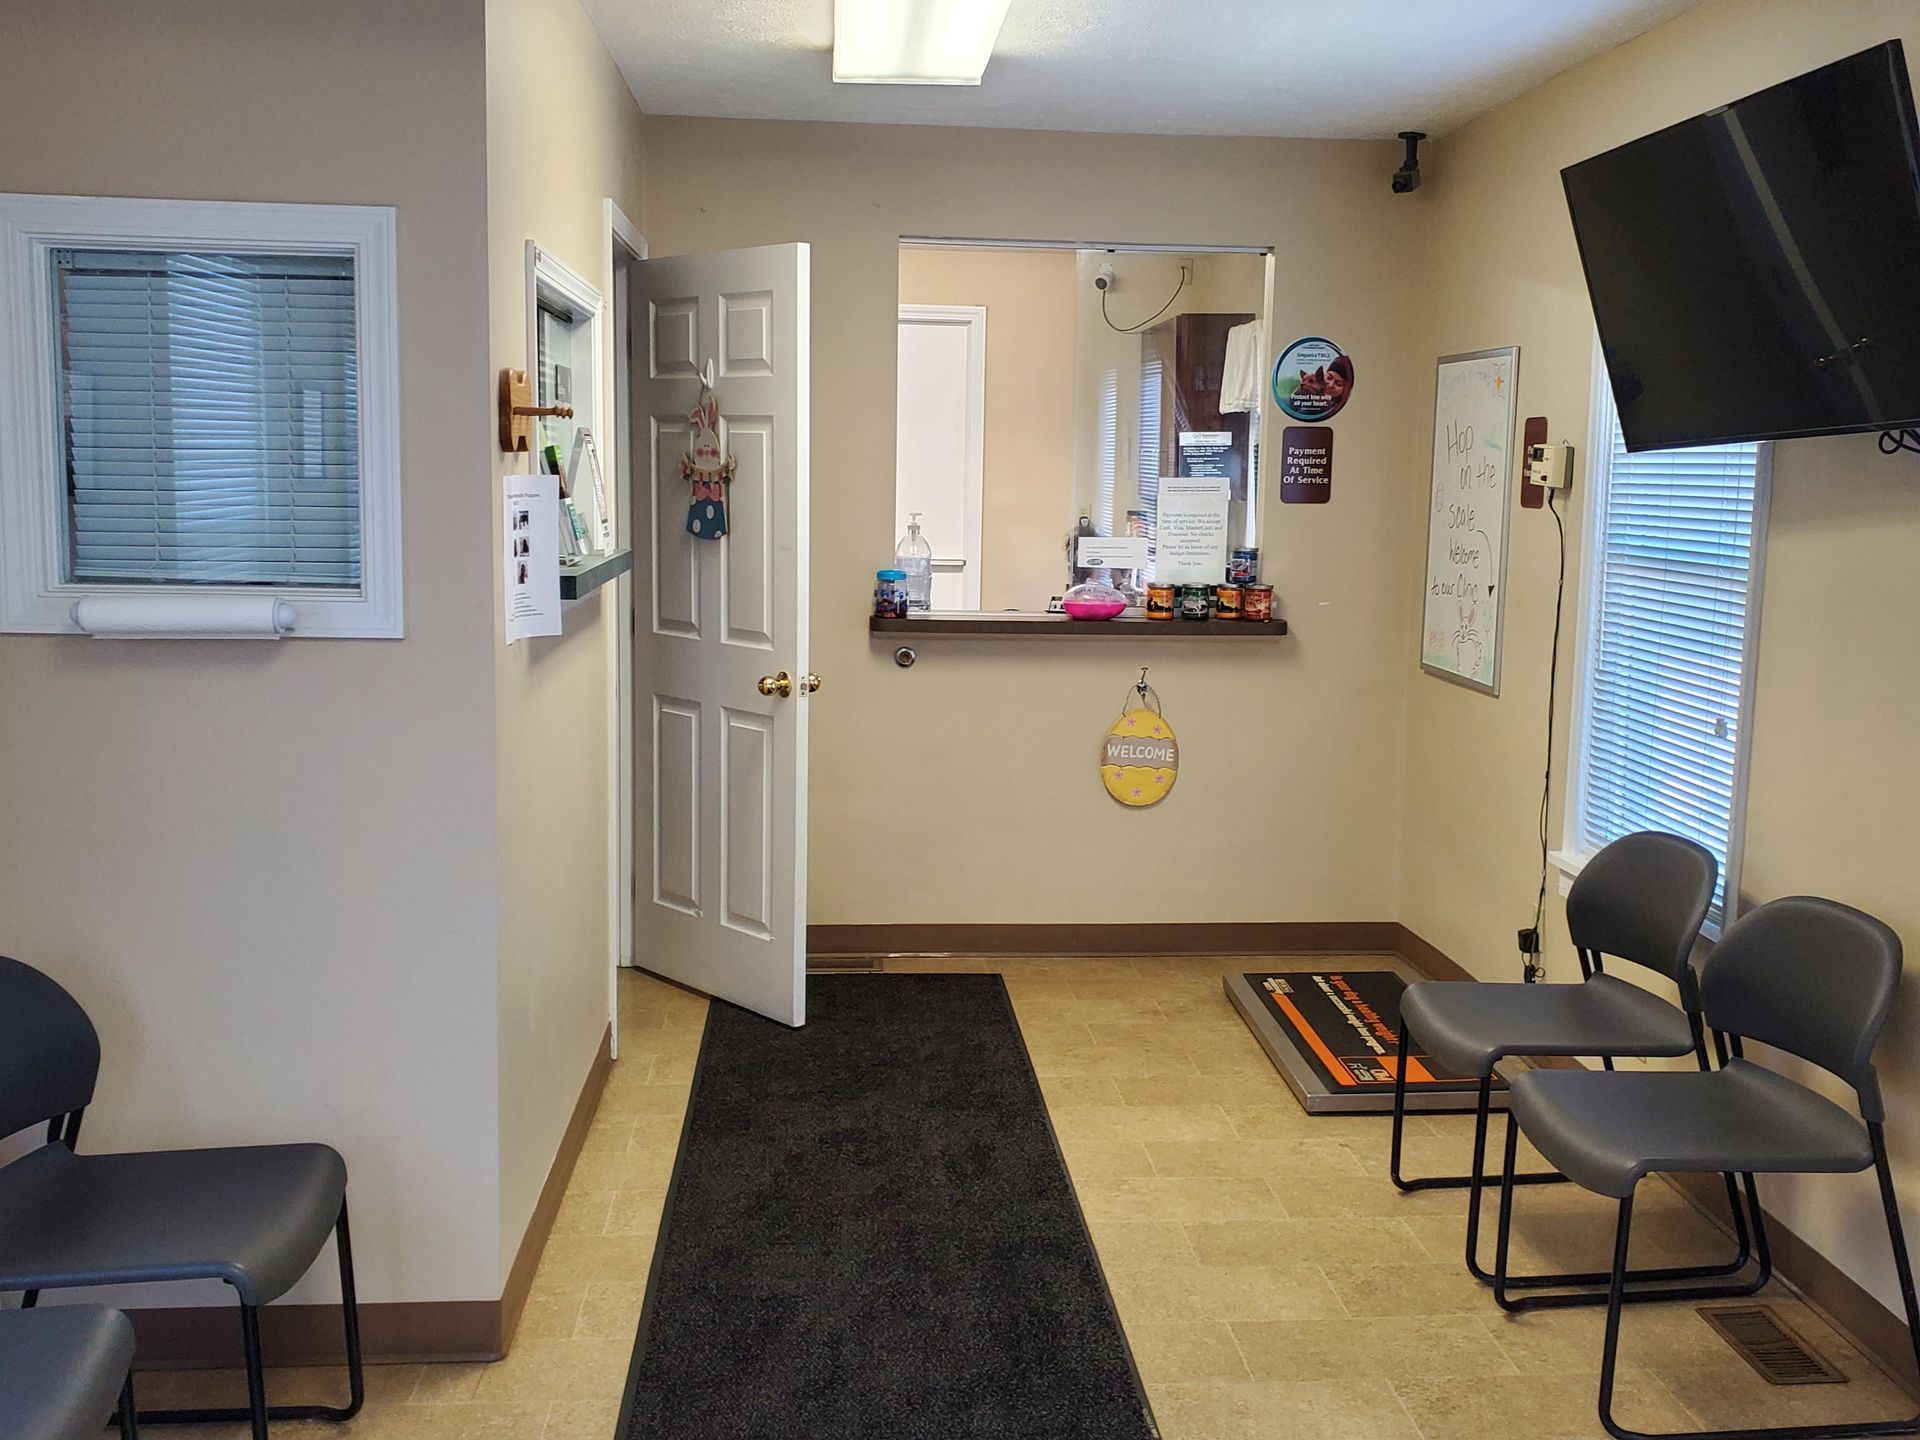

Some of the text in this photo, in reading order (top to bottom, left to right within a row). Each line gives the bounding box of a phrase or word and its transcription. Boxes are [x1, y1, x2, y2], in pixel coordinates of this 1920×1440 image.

[1446, 420, 1474, 464] Hop
[1288, 447, 1326, 456] Payment
[1287, 457, 1327, 466] Required
[1289, 466, 1324, 474] At Time
[1476, 456, 1496, 489] the
[1283, 476, 1329, 484] Of Service
[1107, 743, 1175, 762] WELCOME
